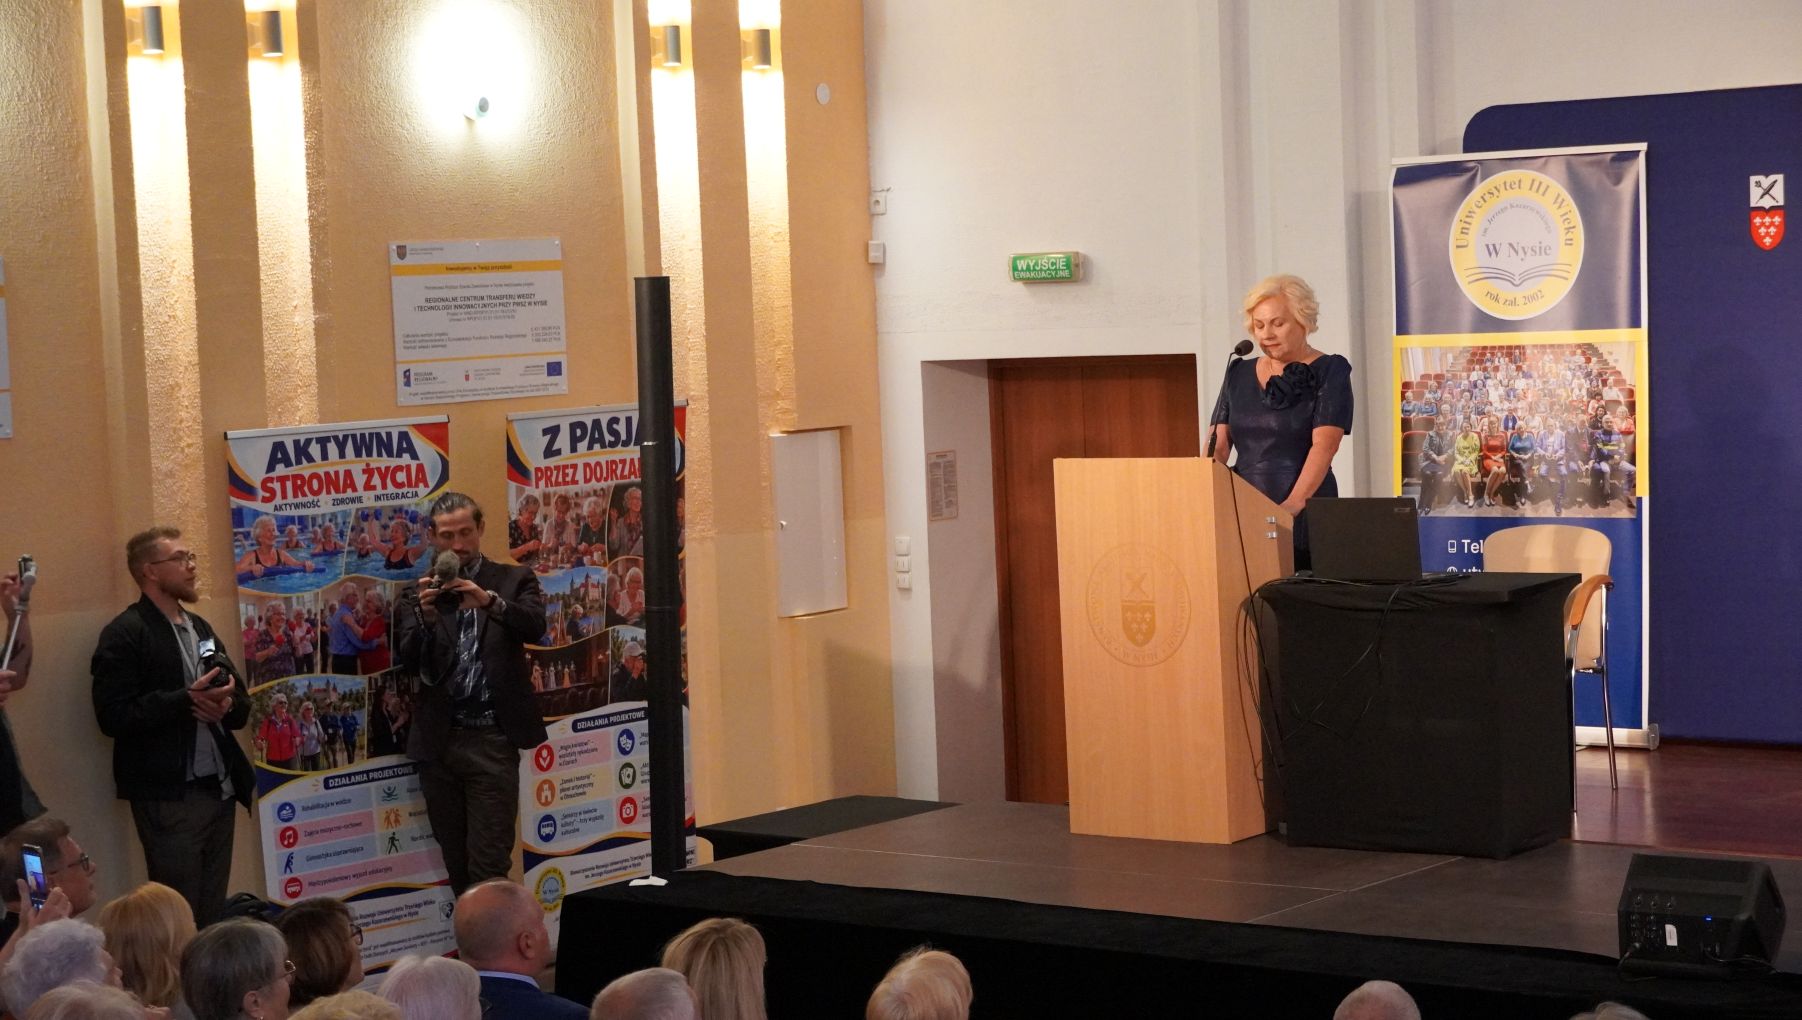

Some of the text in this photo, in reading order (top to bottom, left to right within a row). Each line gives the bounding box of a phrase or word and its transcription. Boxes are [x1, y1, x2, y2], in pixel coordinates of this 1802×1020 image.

[1456, 178, 1576, 250] Uniwersytet III Wieku
[1485, 241, 1552, 262] W Nysie
[1014, 270, 1070, 278] EWAKUACYJNE
[417, 304, 453, 312] TECHNOLOGII
[454, 302, 498, 310] INNOWACYJNYCH
[424, 296, 459, 304] REGIONALNE
[1485, 290, 1500, 306] rok
[1522, 290, 1545, 306] 2002
[265, 430, 420, 474] AKTYWNA
[542, 424, 562, 460] Z
[260, 462, 430, 504] STRONA ŻYCIA
[534, 457, 642, 490] PRZEZ DOJRZA
[273, 490, 419, 513] AKTYWNOŚĆ ZDROWIE INTEGRACJA
[577, 711, 645, 729] DZIAŁANIA PROJEKTOWE
[329, 774, 368, 787] DZIAŁANIA
